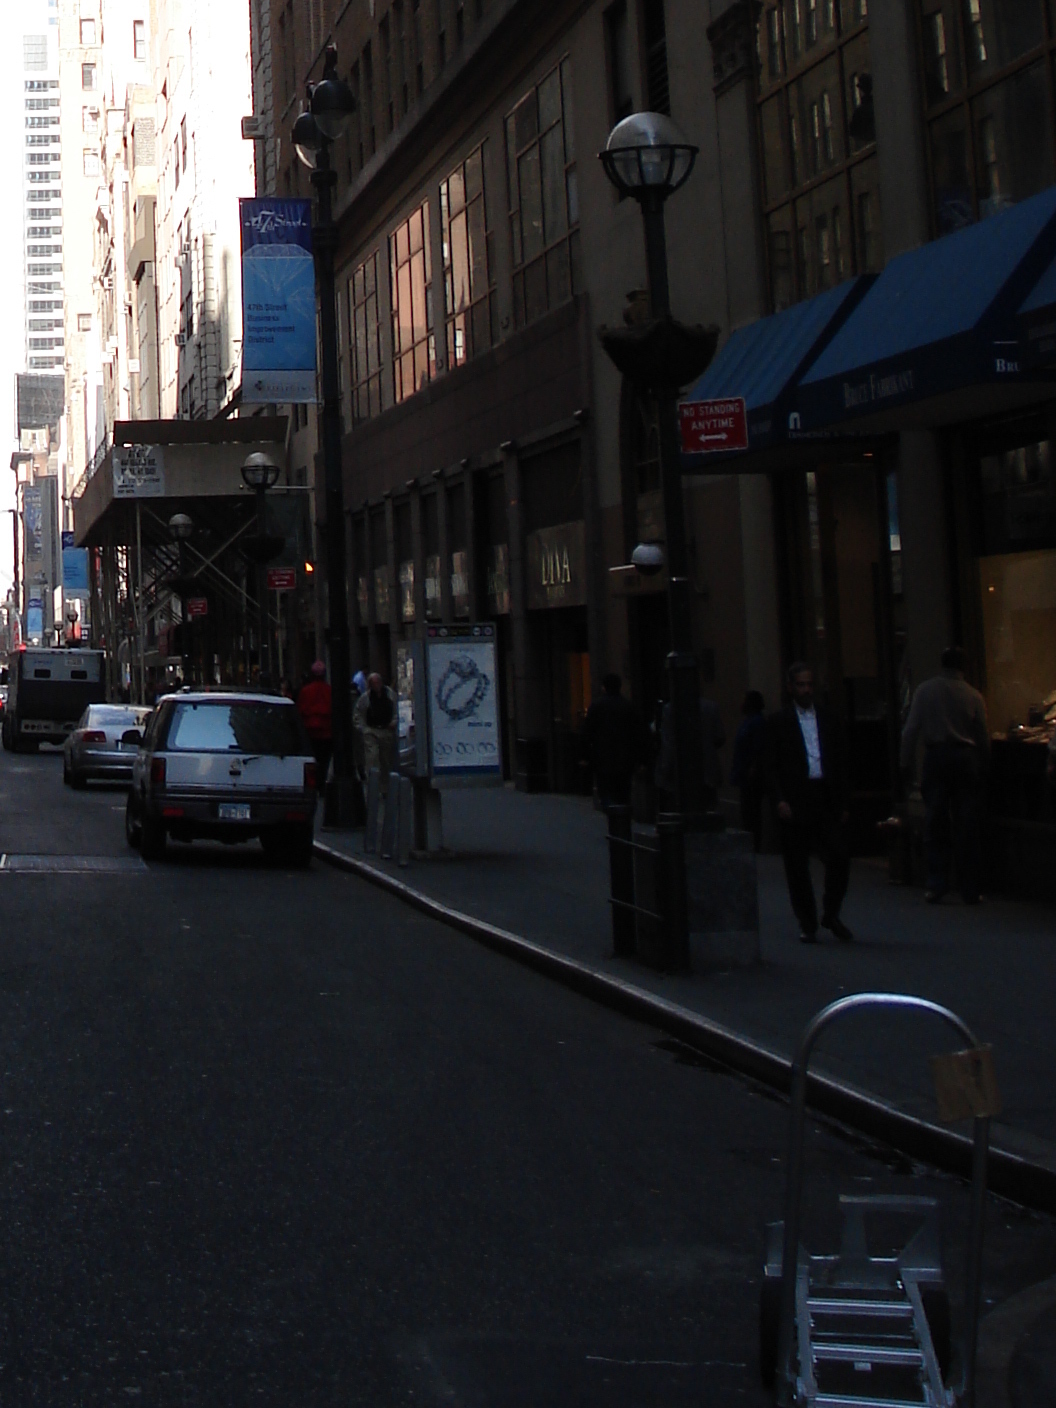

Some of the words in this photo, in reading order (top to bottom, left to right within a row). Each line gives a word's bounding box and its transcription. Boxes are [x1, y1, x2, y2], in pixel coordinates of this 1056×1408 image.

[683, 407, 695, 417] NO
[699, 402, 740, 417] STANDING
[691, 417, 735, 430] ANYTIME
[541, 544, 572, 586] DIVA
